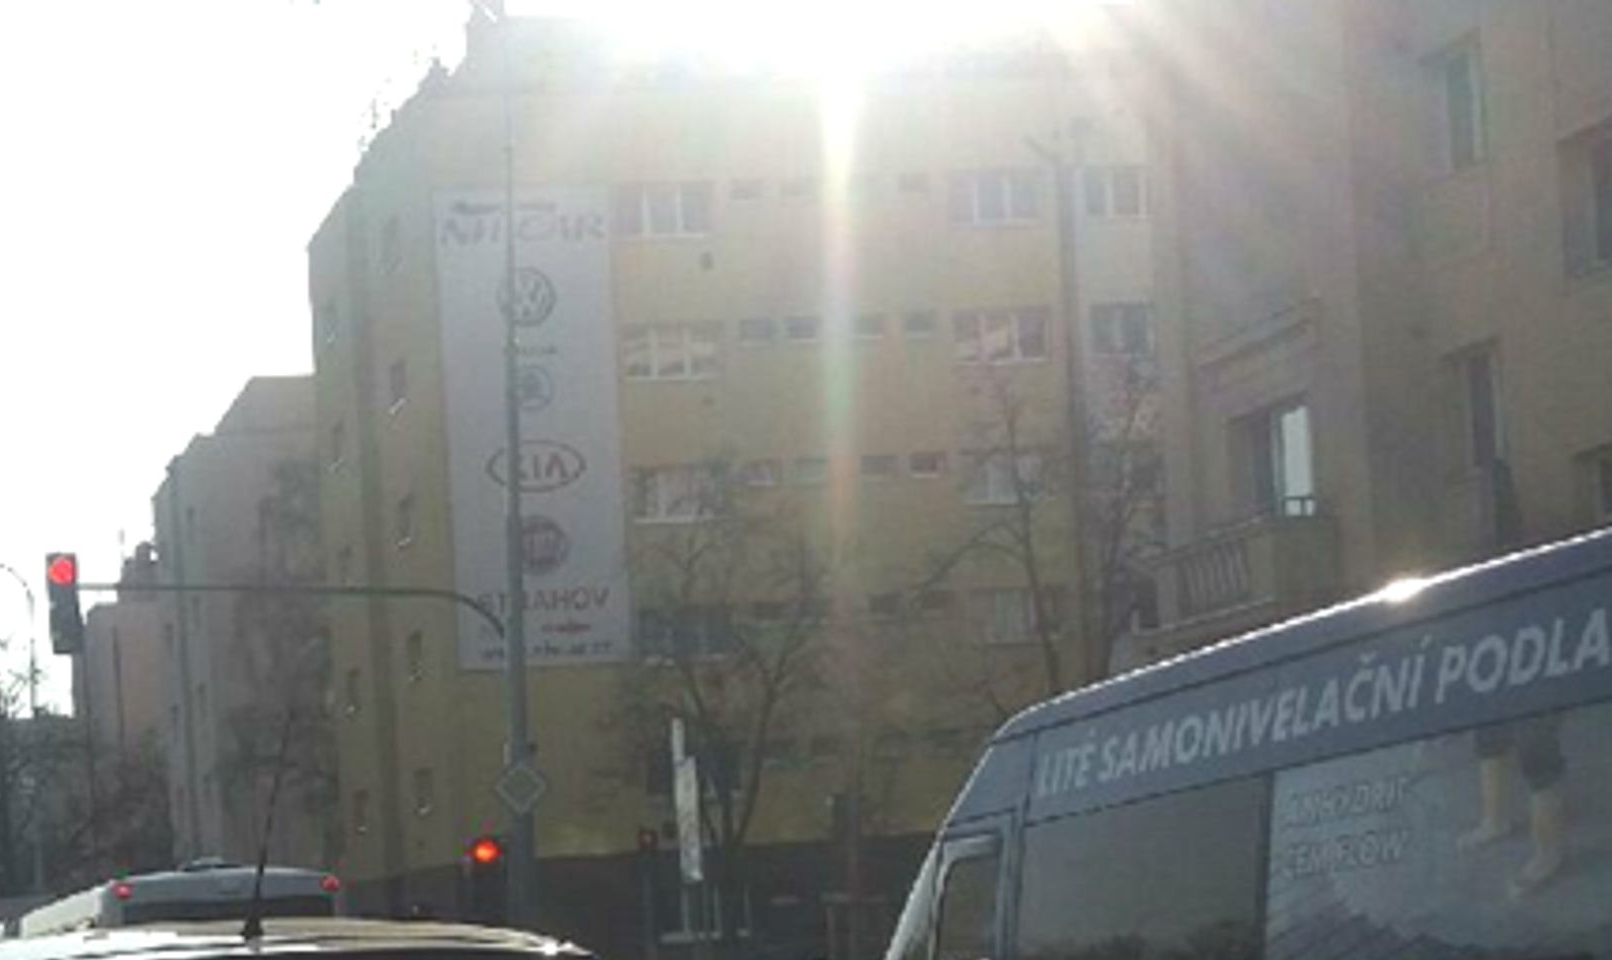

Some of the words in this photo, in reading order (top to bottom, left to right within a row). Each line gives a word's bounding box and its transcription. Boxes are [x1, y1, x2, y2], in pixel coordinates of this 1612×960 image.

[1037, 728, 1096, 797] LITÉ
[1096, 633, 1433, 784] SAMONIVELAČNÍ
[1436, 607, 1612, 704] PODLA
